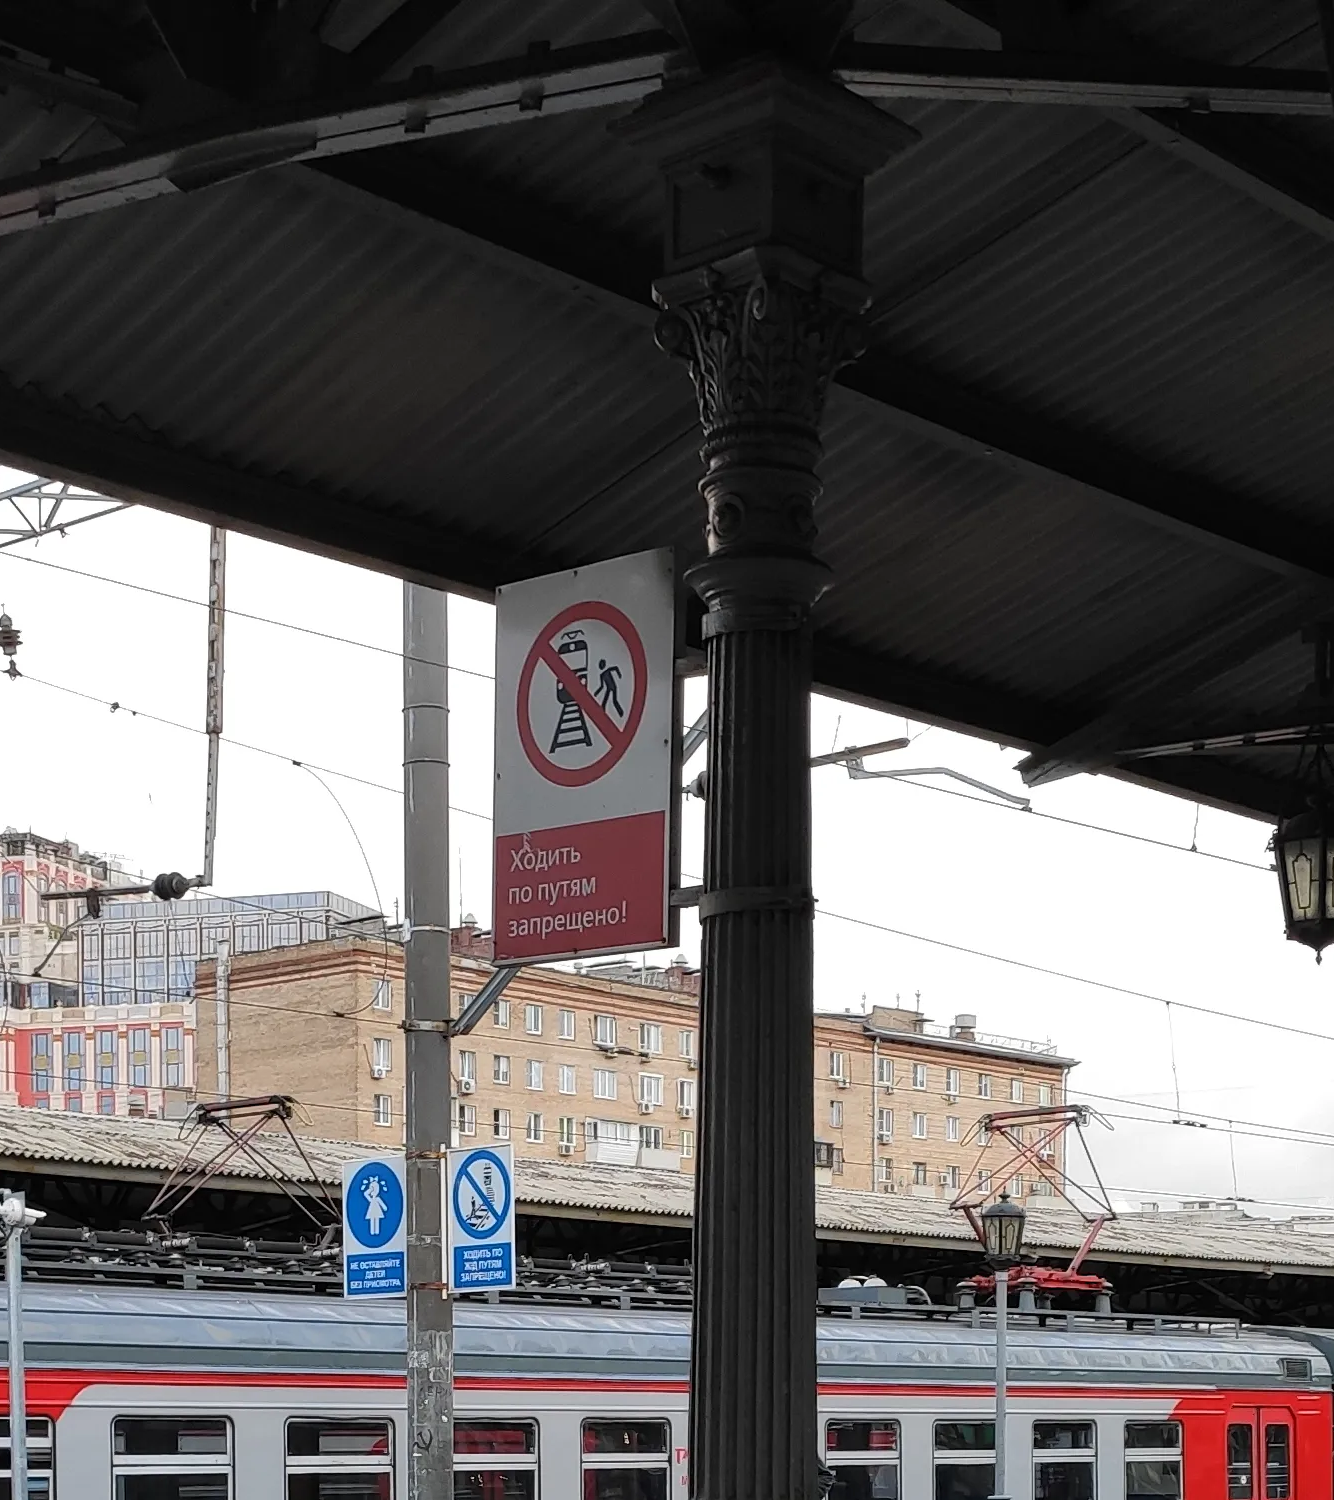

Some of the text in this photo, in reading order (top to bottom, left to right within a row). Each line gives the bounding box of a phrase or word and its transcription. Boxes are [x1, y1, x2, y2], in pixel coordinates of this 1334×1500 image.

[510, 846, 582, 873] Ходить
[508, 876, 596, 906] по путям
[508, 900, 627, 940] запрещено!
